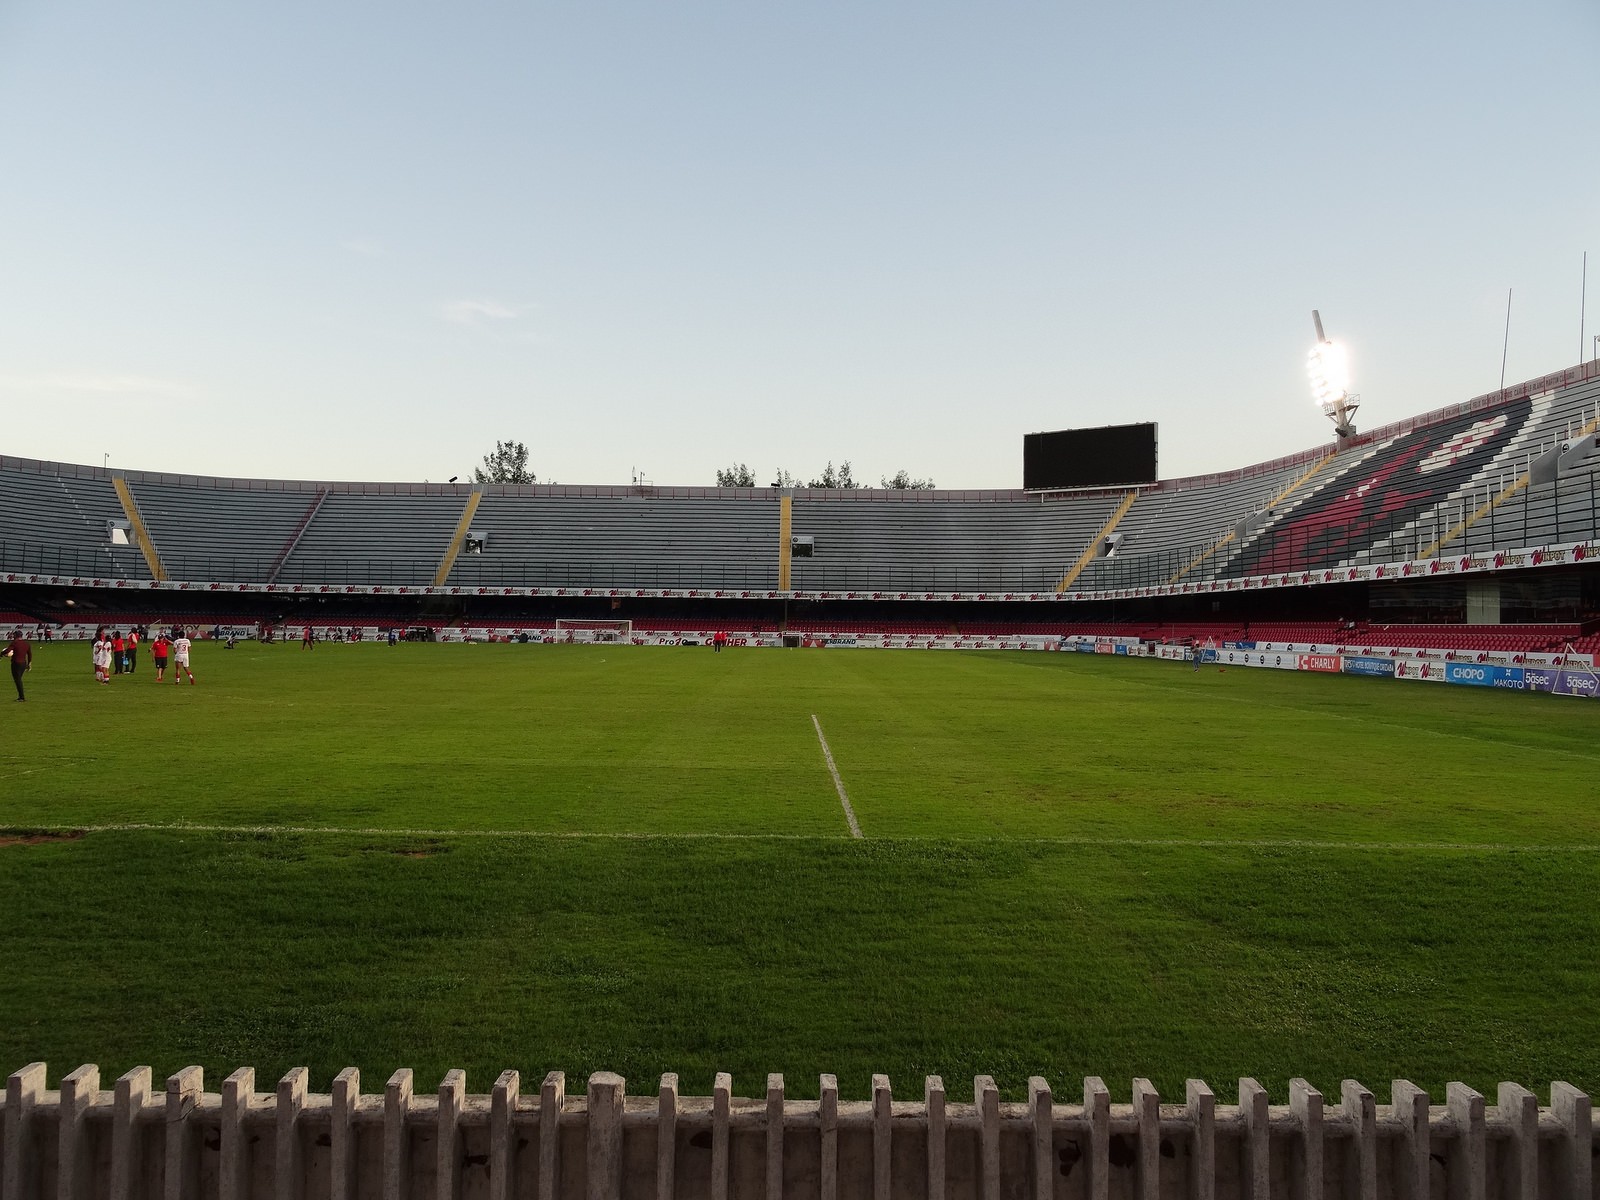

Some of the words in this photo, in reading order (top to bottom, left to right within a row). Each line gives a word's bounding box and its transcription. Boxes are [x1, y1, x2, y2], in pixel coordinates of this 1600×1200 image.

[1310, 658, 1336, 669] CHARLY
[1453, 668, 1484, 680] CHOPO
[1494, 678, 1524, 689] MAKOTO
